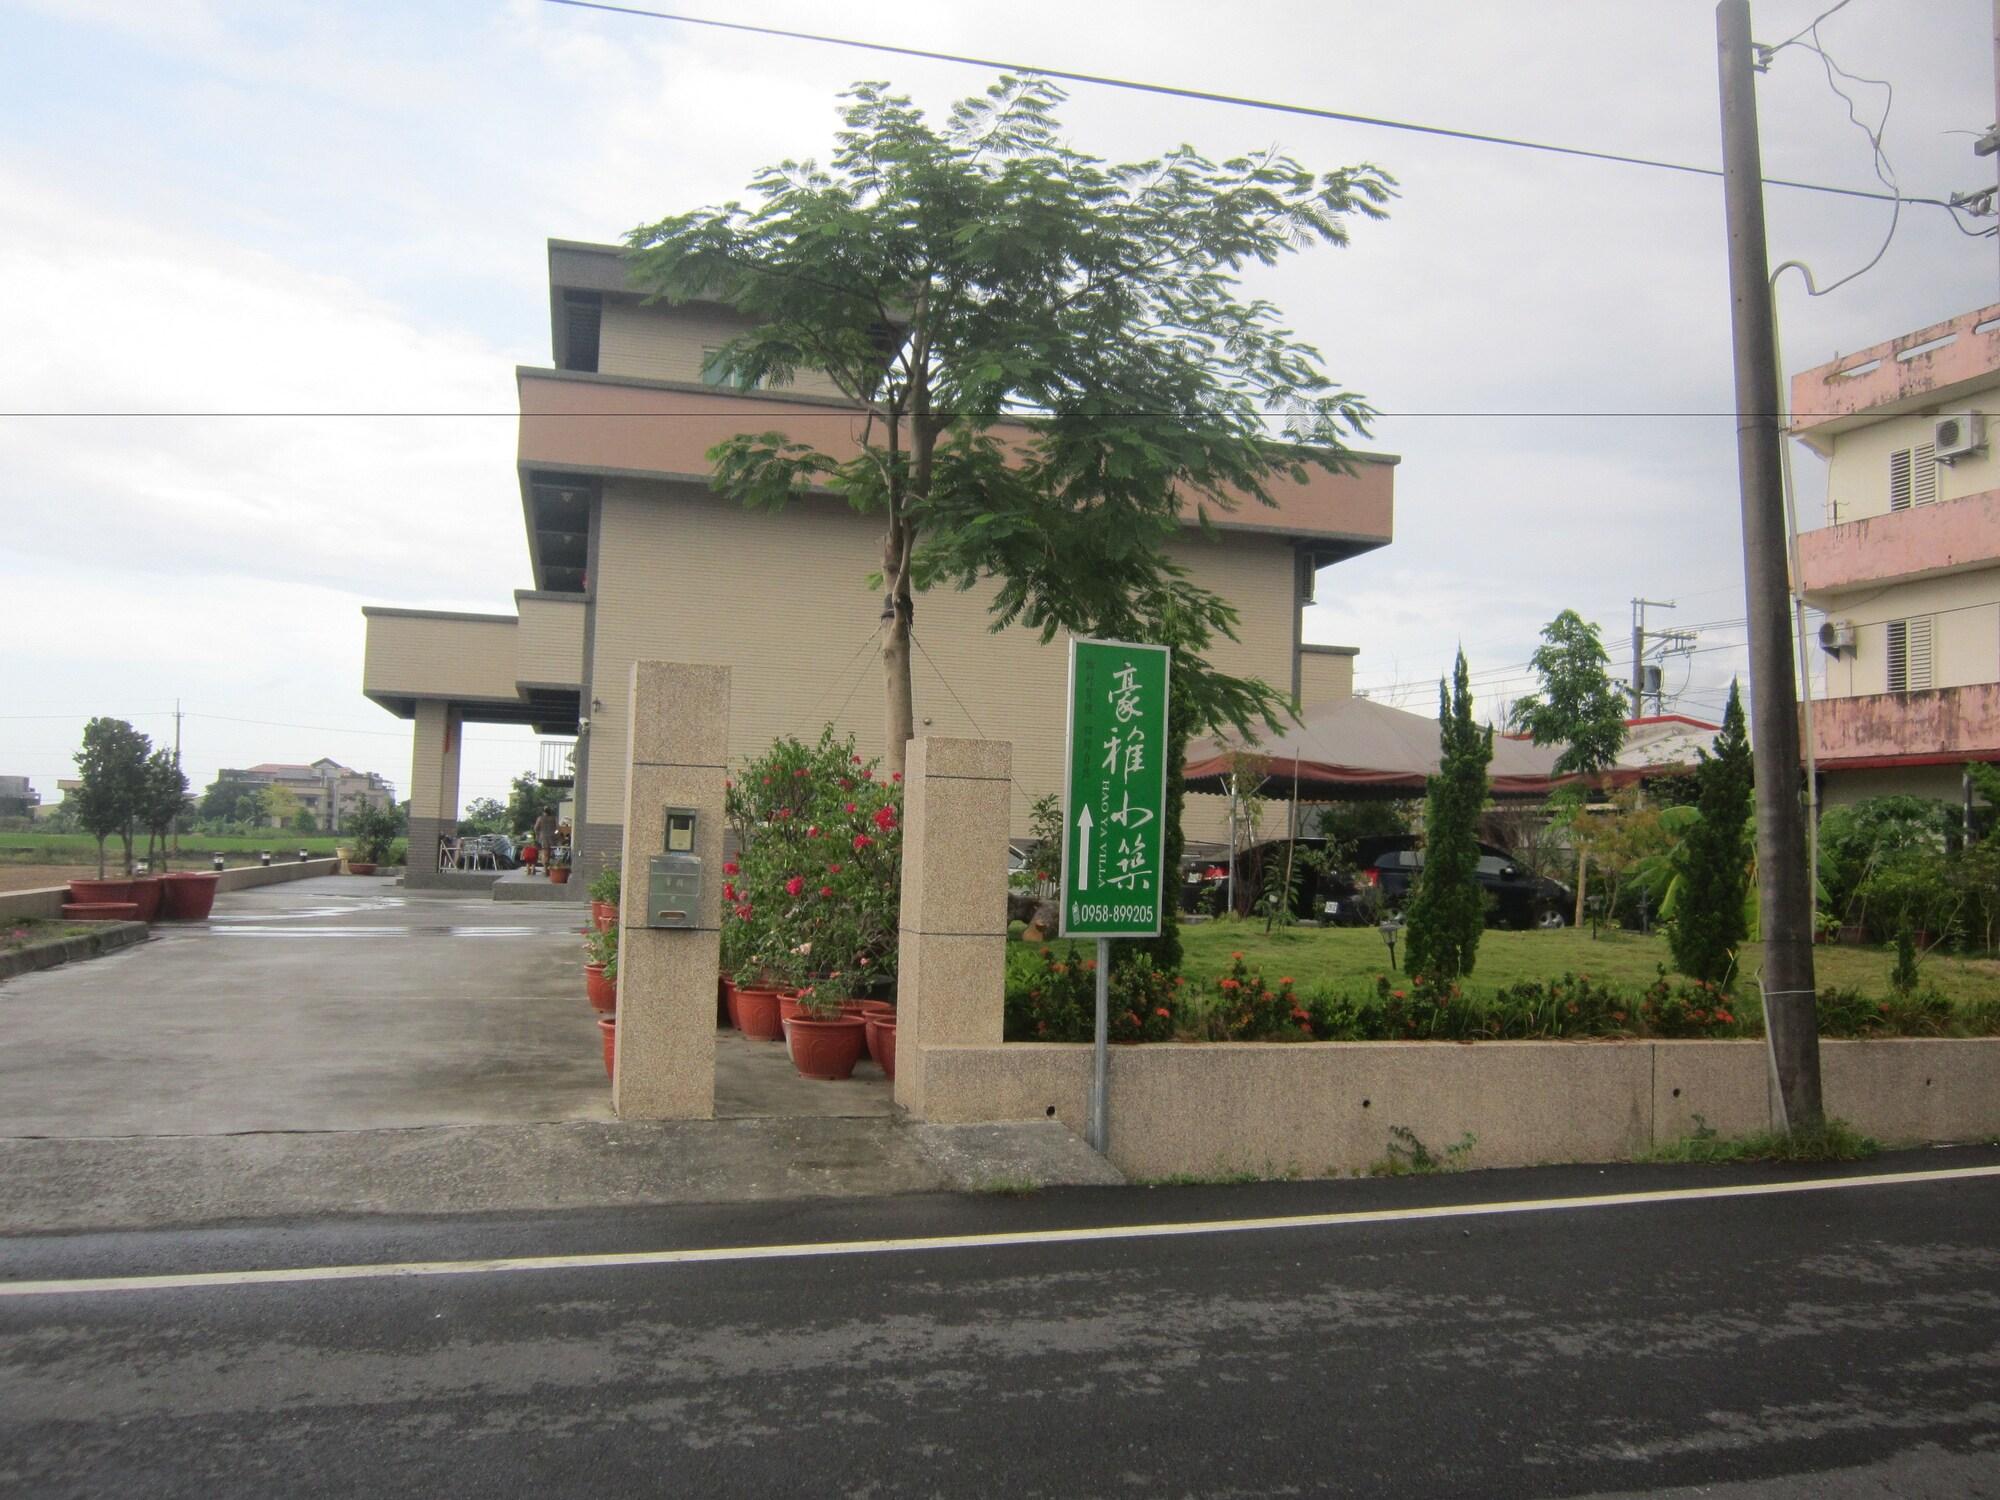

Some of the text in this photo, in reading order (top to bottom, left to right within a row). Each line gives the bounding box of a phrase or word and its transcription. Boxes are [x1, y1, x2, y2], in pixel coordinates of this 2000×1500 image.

[1098, 780, 1110, 888] HAO YA VILLA
[1081, 904, 1153, 923] 0958-899205
